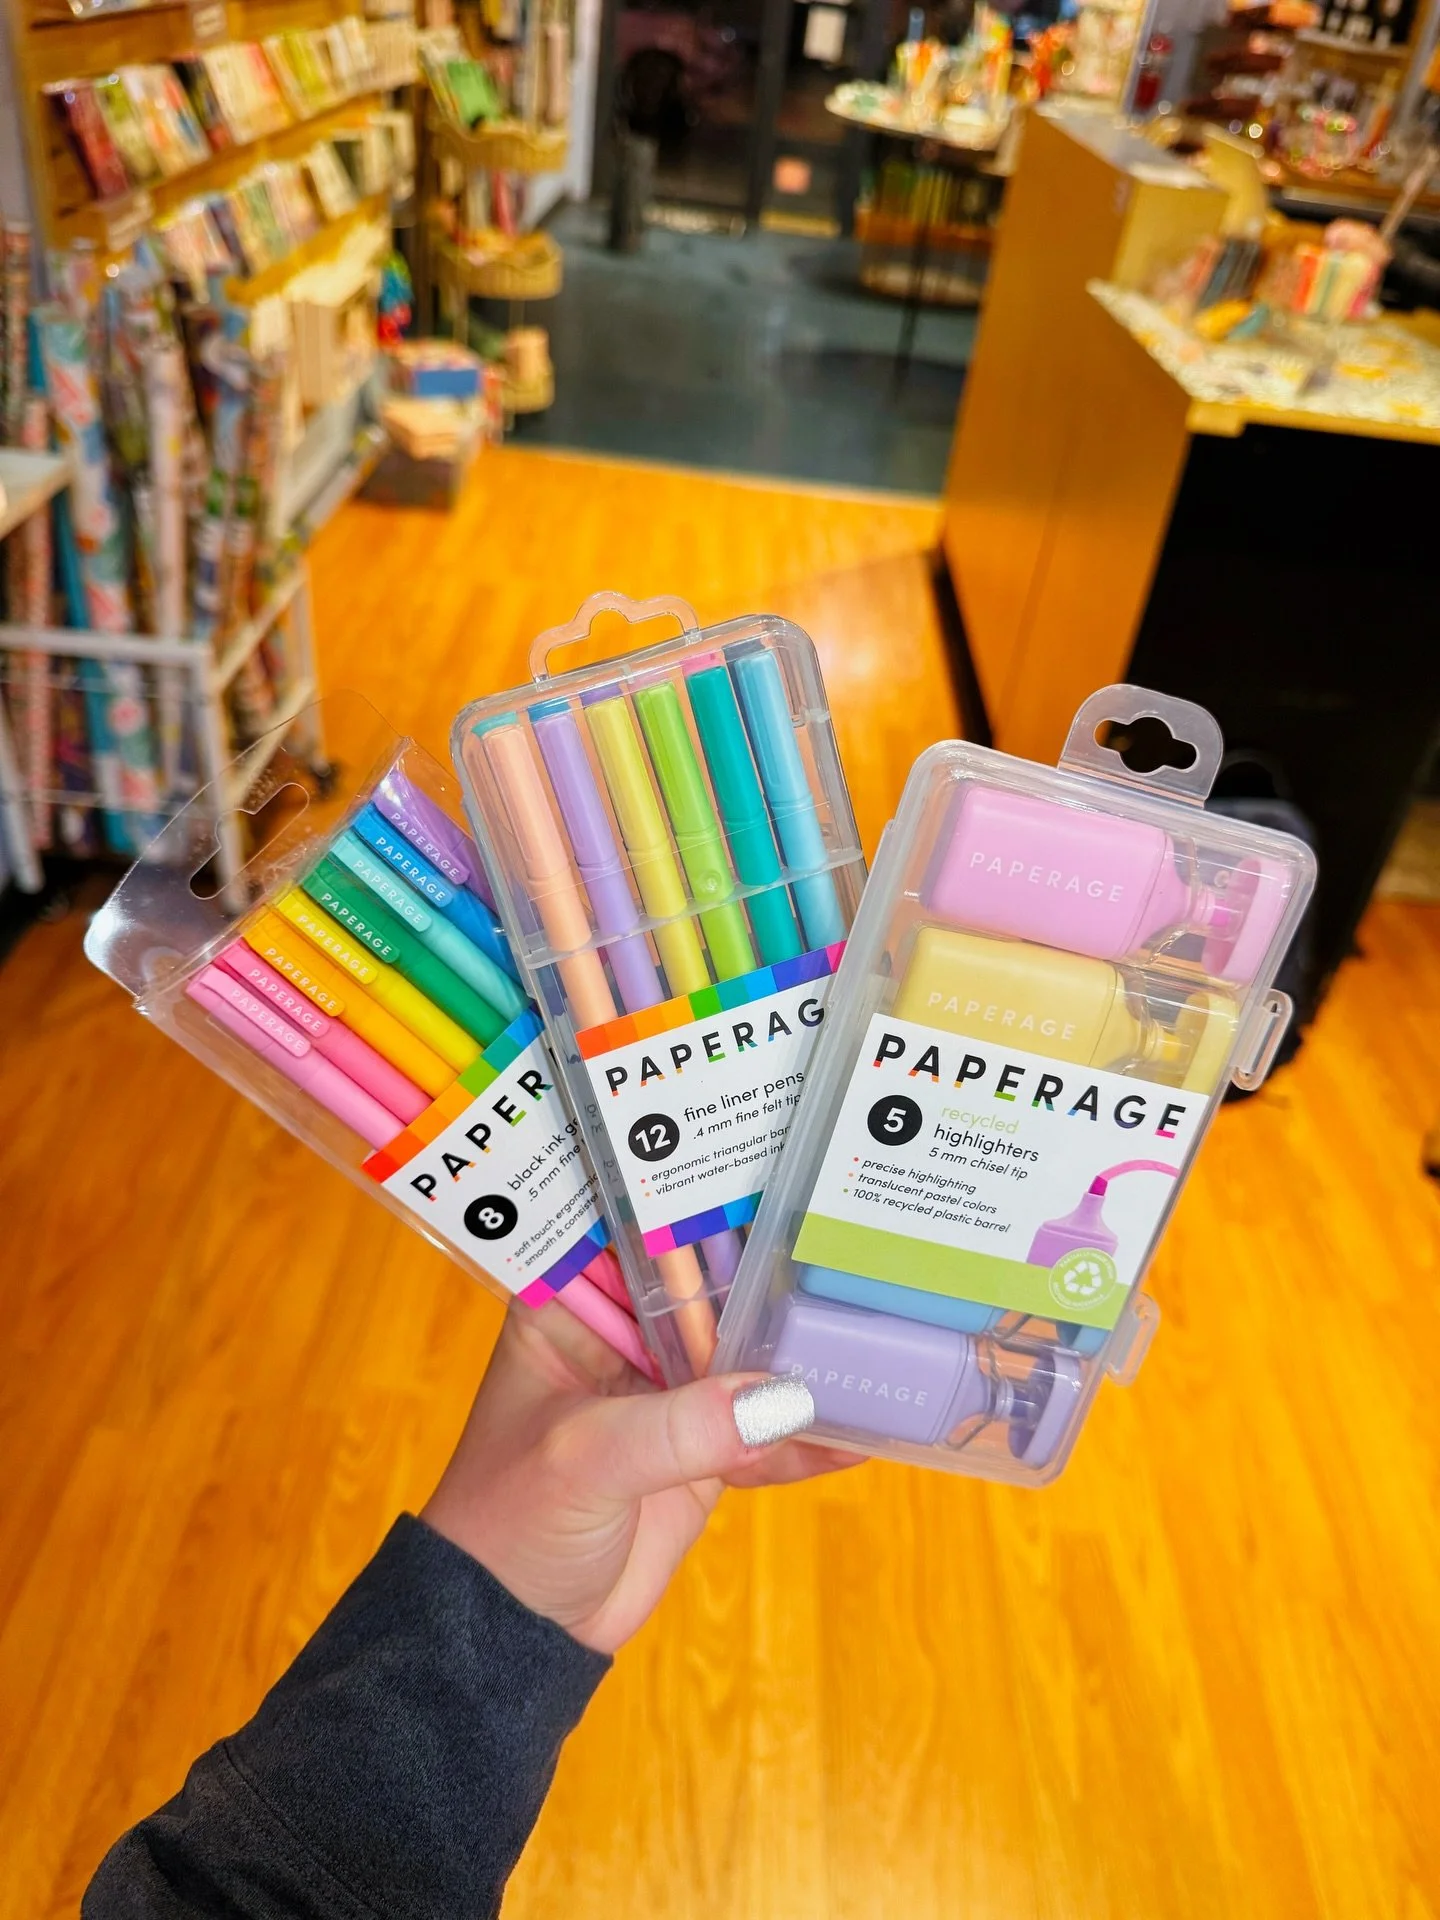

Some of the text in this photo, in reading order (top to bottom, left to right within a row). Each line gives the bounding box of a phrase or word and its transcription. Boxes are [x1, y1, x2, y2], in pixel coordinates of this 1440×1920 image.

[375, 836, 447, 902] PAPERAGE
[391, 811, 460, 879] PAPERAGE
[353, 859, 424, 925] PAPERAGE
[969, 851, 1125, 904] PAPERAGE
[297, 914, 370, 979] PAPERAGE
[320, 892, 392, 957] PAPERAGE
[249, 968, 322, 1031] PAPERAGE
[265, 947, 338, 1011] PAPERAGE
[231, 988, 304, 1050] PAPERAGE
[927, 991, 1077, 1041] PAPERAGE
[605, 998, 826, 1097] PAPERAG
[684, 1072, 805, 1122] fine liner pens
[872, 1032, 1187, 1139] PAPERAGE
[410, 1047, 559, 1202] PAPER
[634, 1123, 671, 1153] 12
[693, 1127, 704, 1140] .4
[708, 1118, 732, 1134] mm
[735, 1109, 759, 1124] fine
[763, 1099, 782, 1115] felt
[883, 1107, 907, 1133] 5
[933, 1123, 1039, 1162] highlighters
[941, 1105, 1019, 1134] recycled
[507, 1154, 546, 1190] black
[542, 1133, 566, 1155] ink
[528, 1144, 581, 1202] .5 mm fine
[651, 1125, 791, 1182] ergonomic triangular bar
[655, 1174, 695, 1195] vibrant
[697, 1148, 768, 1180] water-based
[861, 1158, 977, 1195] precise highlighting
[928, 1147, 1028, 1181] 5 mm chisel tip
[478, 1207, 505, 1230] 8
[514, 1173, 598, 1258] soft touch ergonomic
[853, 1188, 1011, 1233] 100% recycled plastic barrel
[857, 1173, 997, 1214] translucent pastel colors
[525, 1235, 557, 1266] smooth
[555, 1228, 565, 1238] &
[790, 1363, 928, 1407] PAPERAGE
